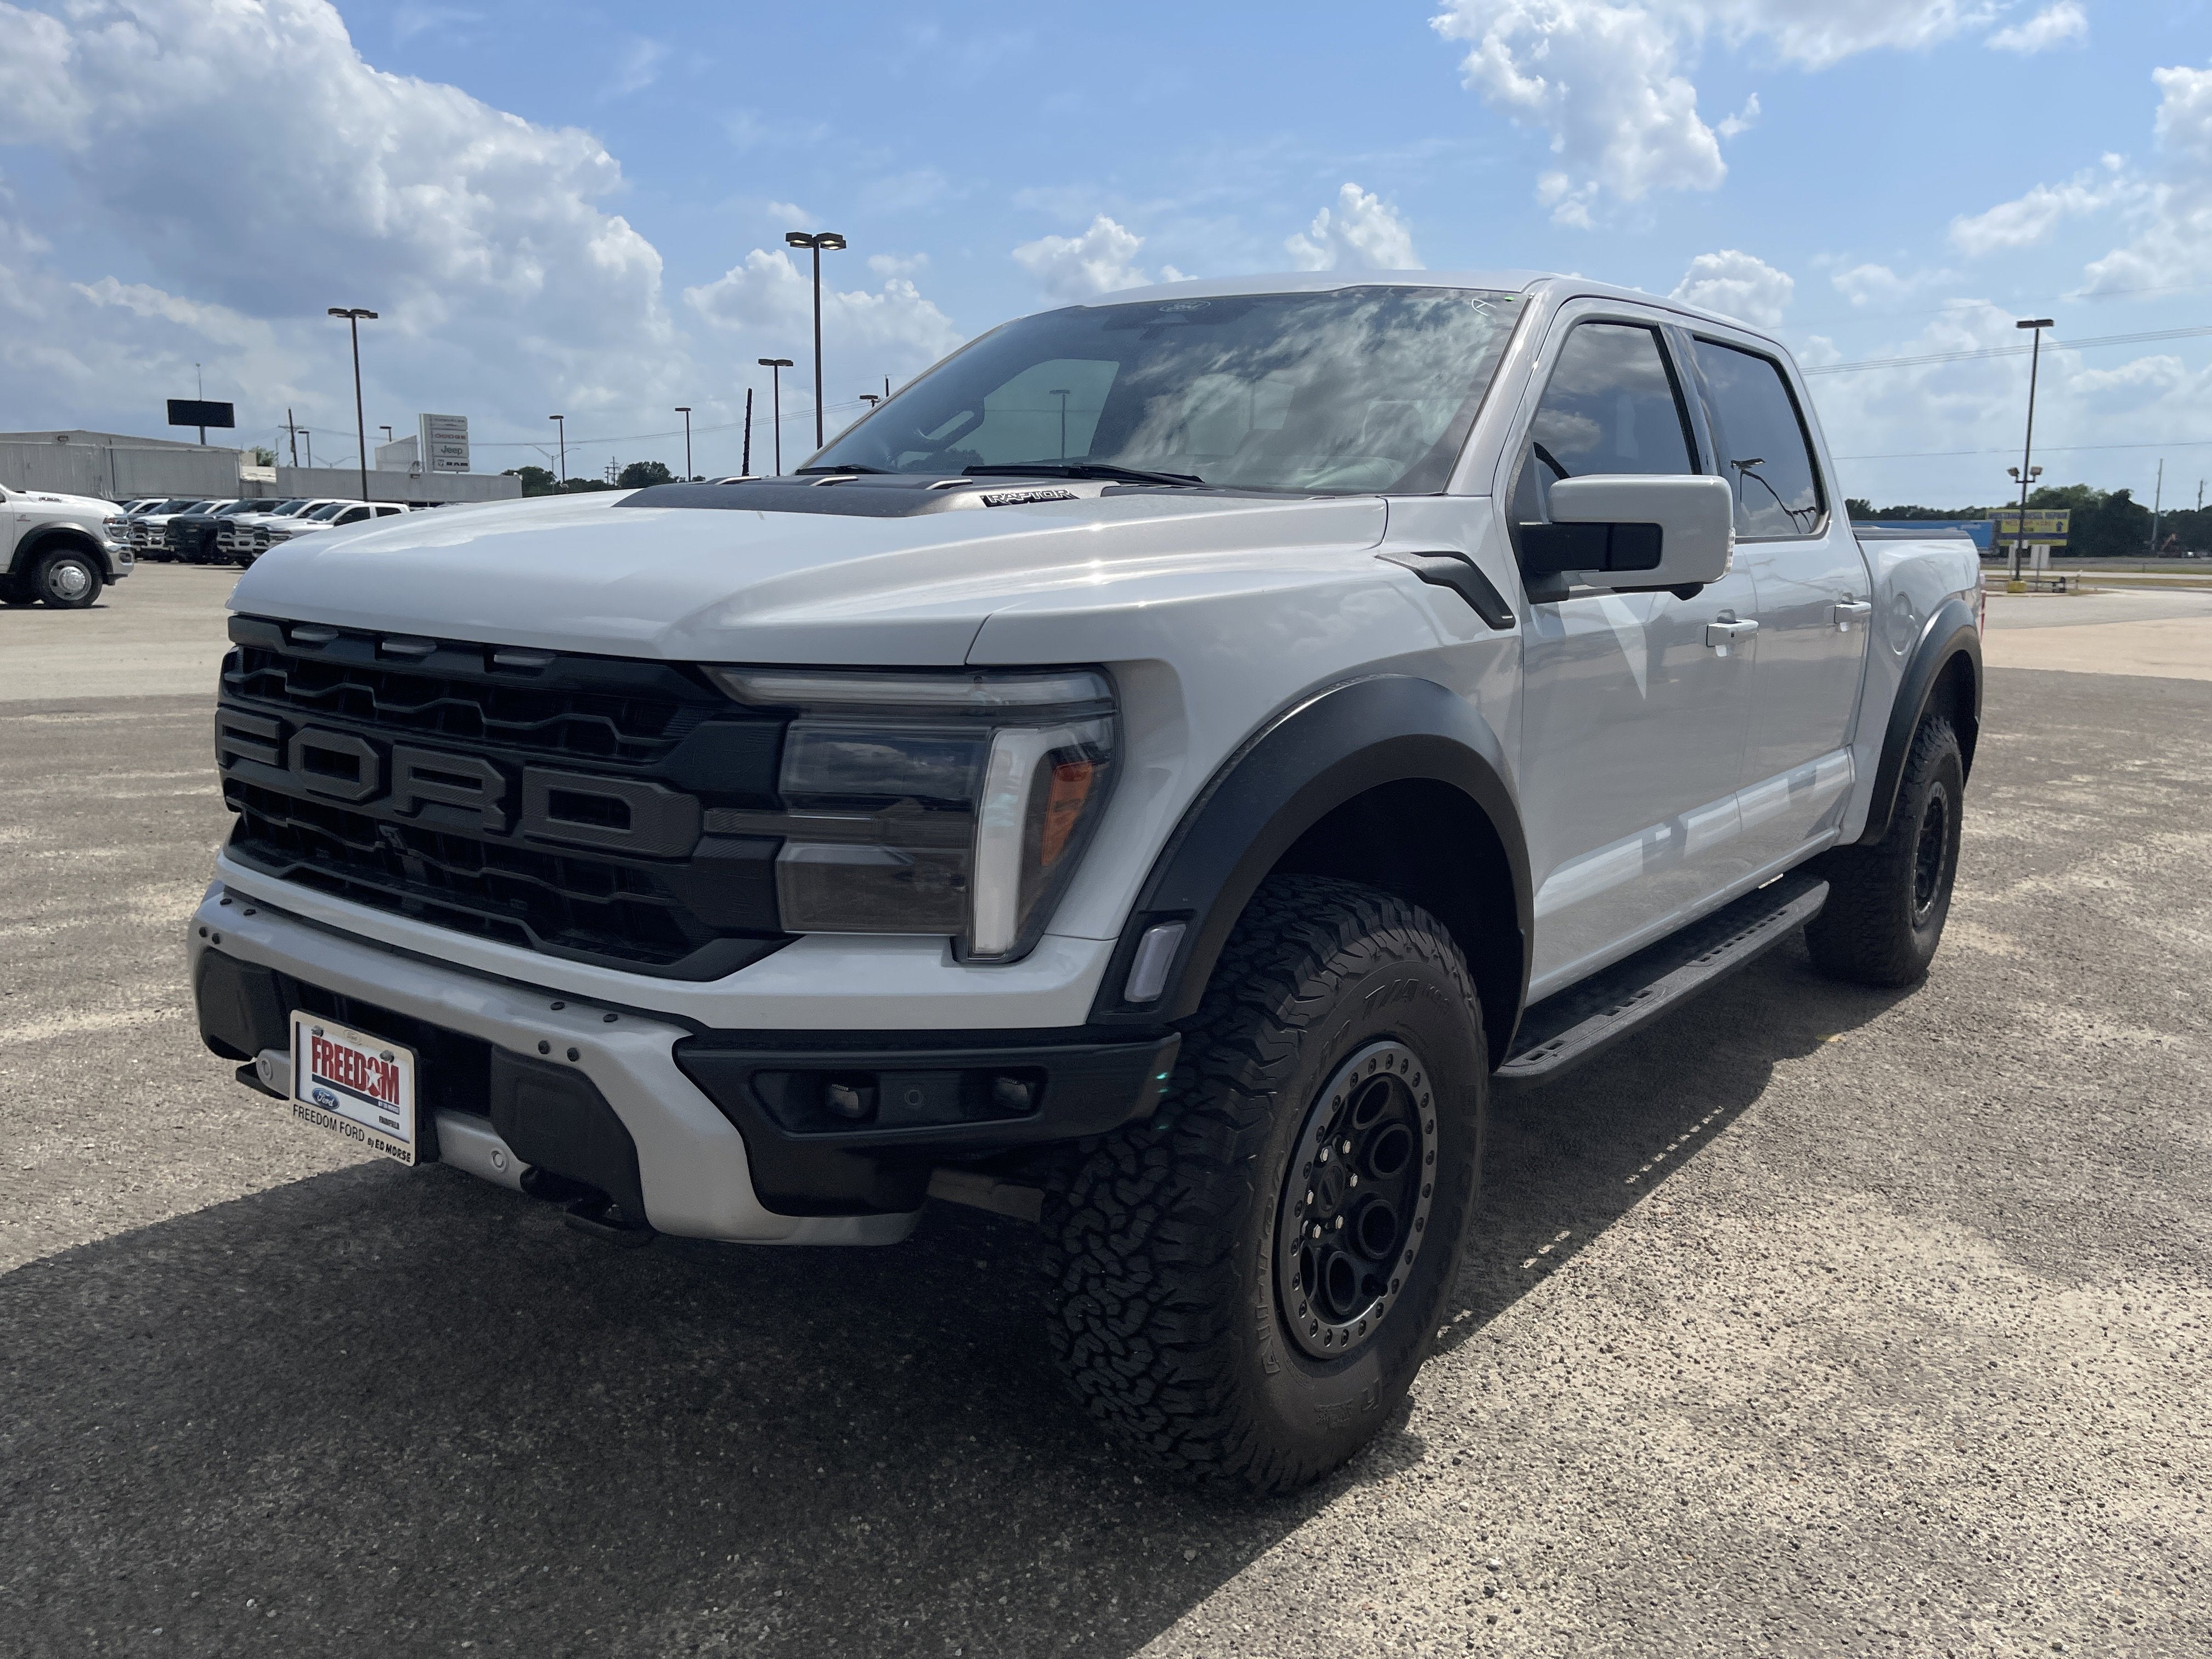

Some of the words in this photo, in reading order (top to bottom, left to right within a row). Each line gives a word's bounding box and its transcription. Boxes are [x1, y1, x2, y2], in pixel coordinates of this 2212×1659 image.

[441, 445, 462, 455] Jeep
[985, 489, 1074, 505] RAPTOR
[215, 707, 703, 859] FORD
[312, 1035, 399, 1105] FREEDOM
[315, 1090, 336, 1107] Ford
[293, 1104, 337, 1131] FREEDOM
[339, 1121, 364, 1142] FORD
[375, 1139, 384, 1151] ED
[386, 1143, 411, 1163] MORSE
